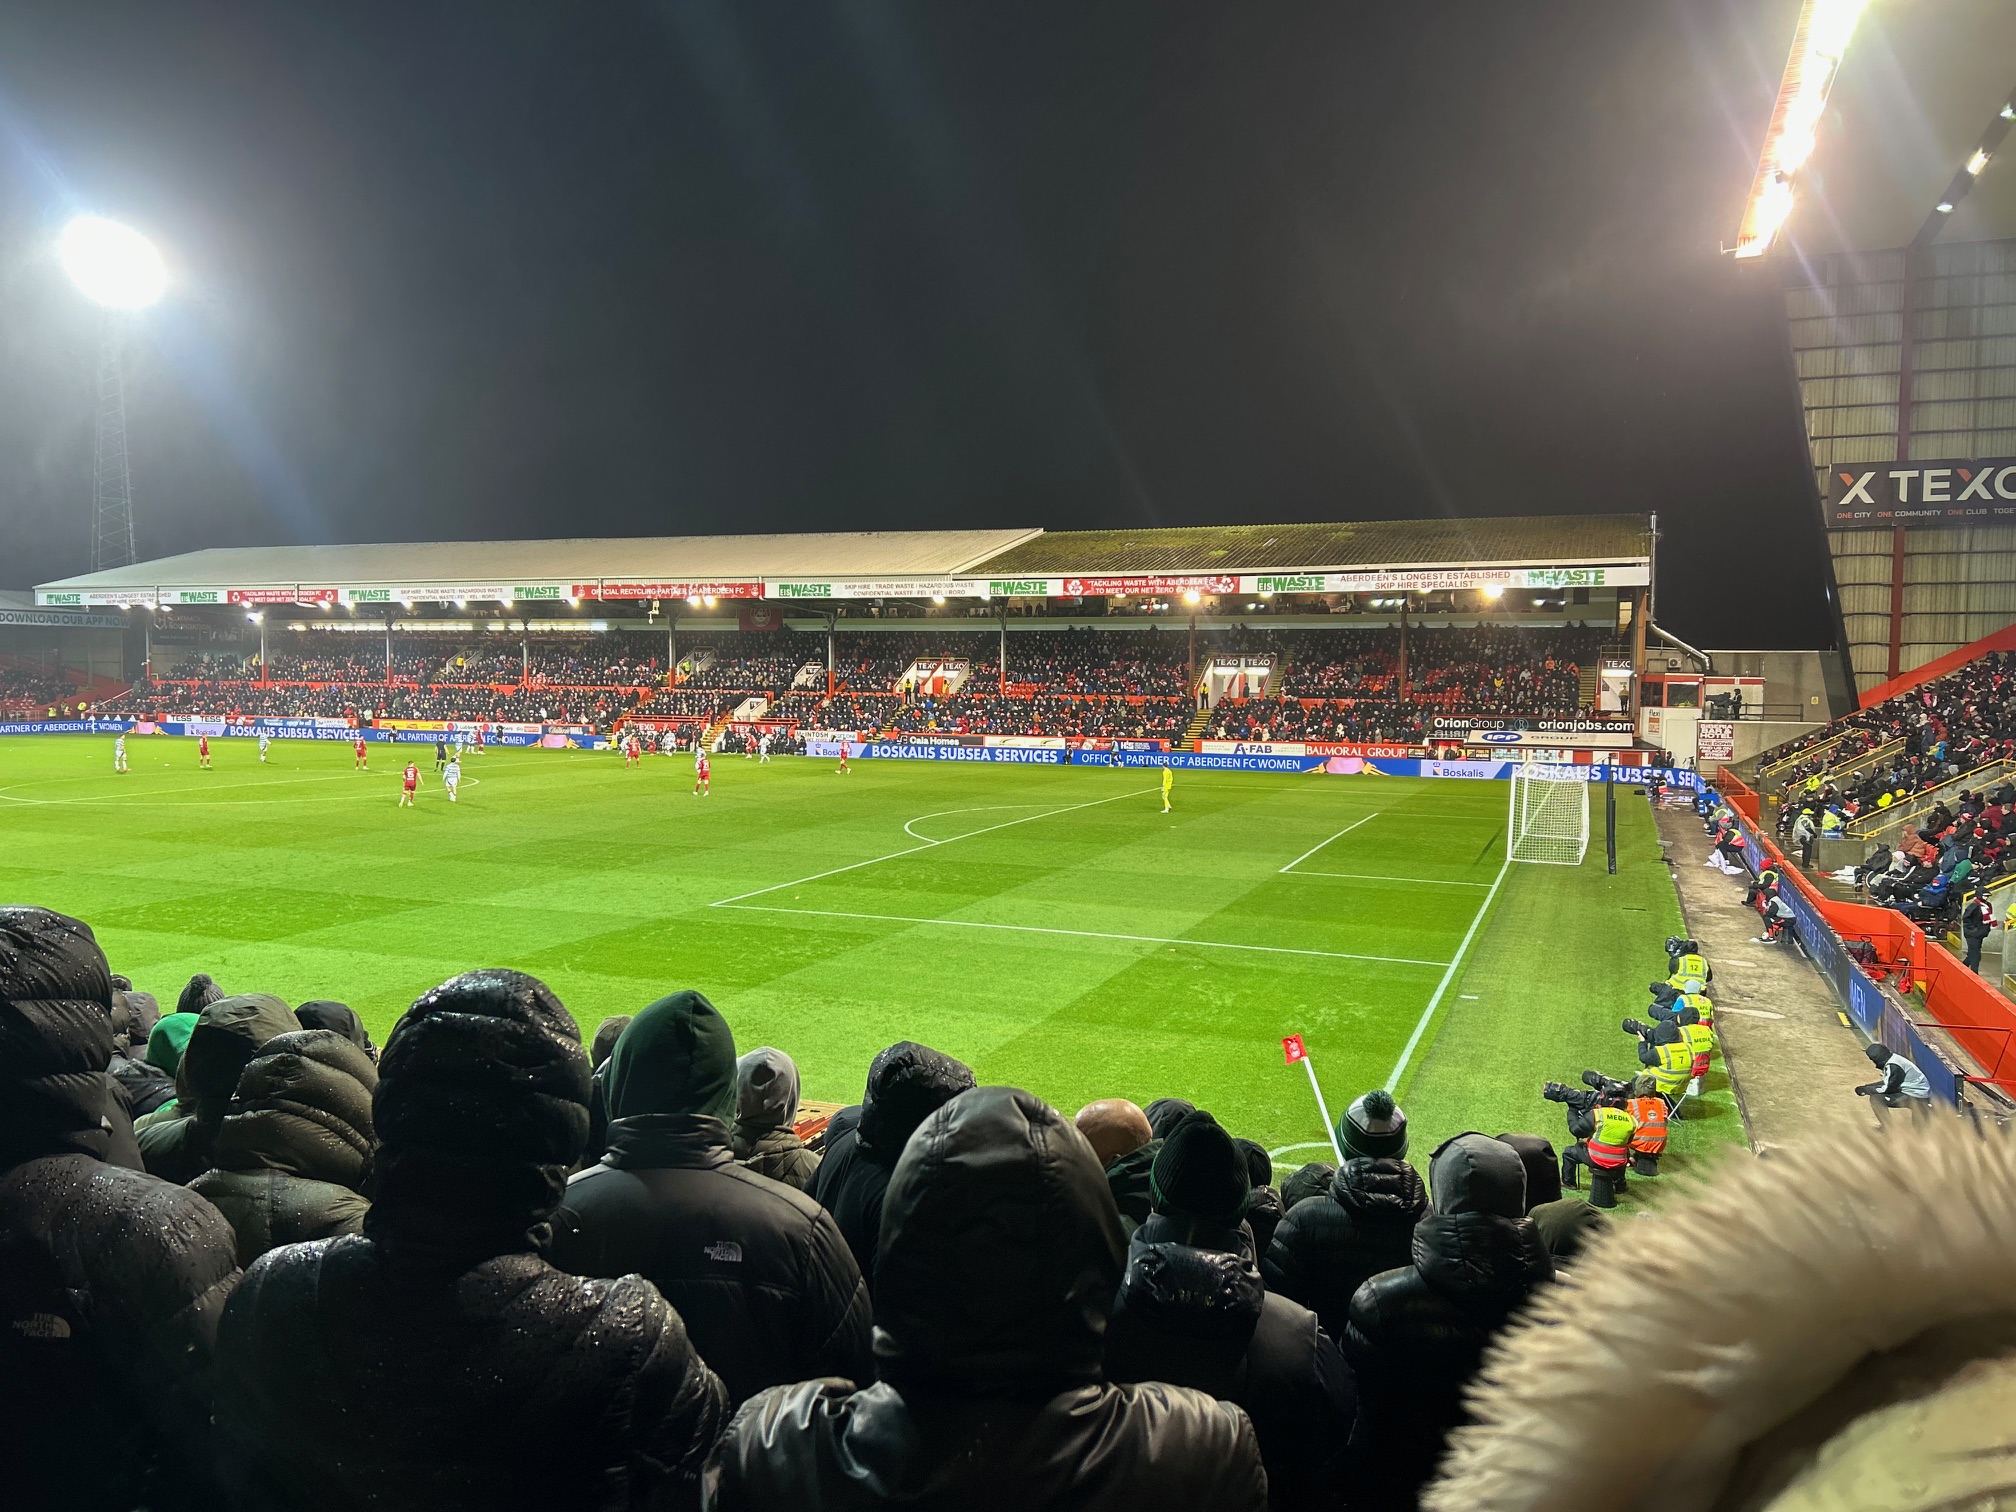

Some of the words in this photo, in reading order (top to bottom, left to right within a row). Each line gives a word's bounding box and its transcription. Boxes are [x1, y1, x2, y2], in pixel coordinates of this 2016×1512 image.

[1895, 510, 1942, 518] COMMUNITY
[1340, 574, 1398, 582] ABERDEEN'S
[1400, 572, 1443, 581] LONGEST
[1446, 571, 1510, 580] ESTABLISHED
[1002, 582, 1047, 594] WASTE
[1272, 576, 1325, 592] WASTE
[1421, 580, 1473, 588] SPECIALIST
[358, 590, 390, 601] WASTE
[524, 587, 560, 598] WASTE
[790, 584, 831, 596] WASTE
[54, 594, 80, 604] WASTE
[189, 592, 218, 602] WASTE
[0, 613, 60, 624] DOWNLOAD
[62, 614, 82, 625] OUR
[86, 616, 103, 626] APP
[106, 616, 129, 626] NOW
[44, 724, 84, 732] ABERDEEN
[1434, 717, 1504, 731] OrionGroup
[1538, 717, 1634, 732] orionjobs.com
[278, 727, 314, 738] SUBSEA
[316, 728, 360, 740] SERVICES
[408, 733, 438, 741] PARTNER
[487, 735, 496, 744] FC
[1486, 734, 1518, 742] IPP
[910, 736, 930, 744] Cala
[932, 736, 960, 746] Homes
[872, 746, 936, 758] BOSKALIS
[939, 747, 990, 760] SUBSEA
[994, 748, 1058, 762] SERVICES
[1306, 746, 1364, 756] BALMORAL
[1367, 747, 1406, 758] GROUP
[1126, 756, 1170, 765] PARTNER
[1172, 757, 1184, 766] OF
[1187, 757, 1240, 768] ABERDEEN
[1243, 759, 1256, 768] FC
[1257, 759, 1300, 770] WOMEN
[1442, 768, 1484, 778] Boskalis
[1679, 1056, 1684, 1064] 7
[1606, 1114, 1630, 1122] MEDIA
